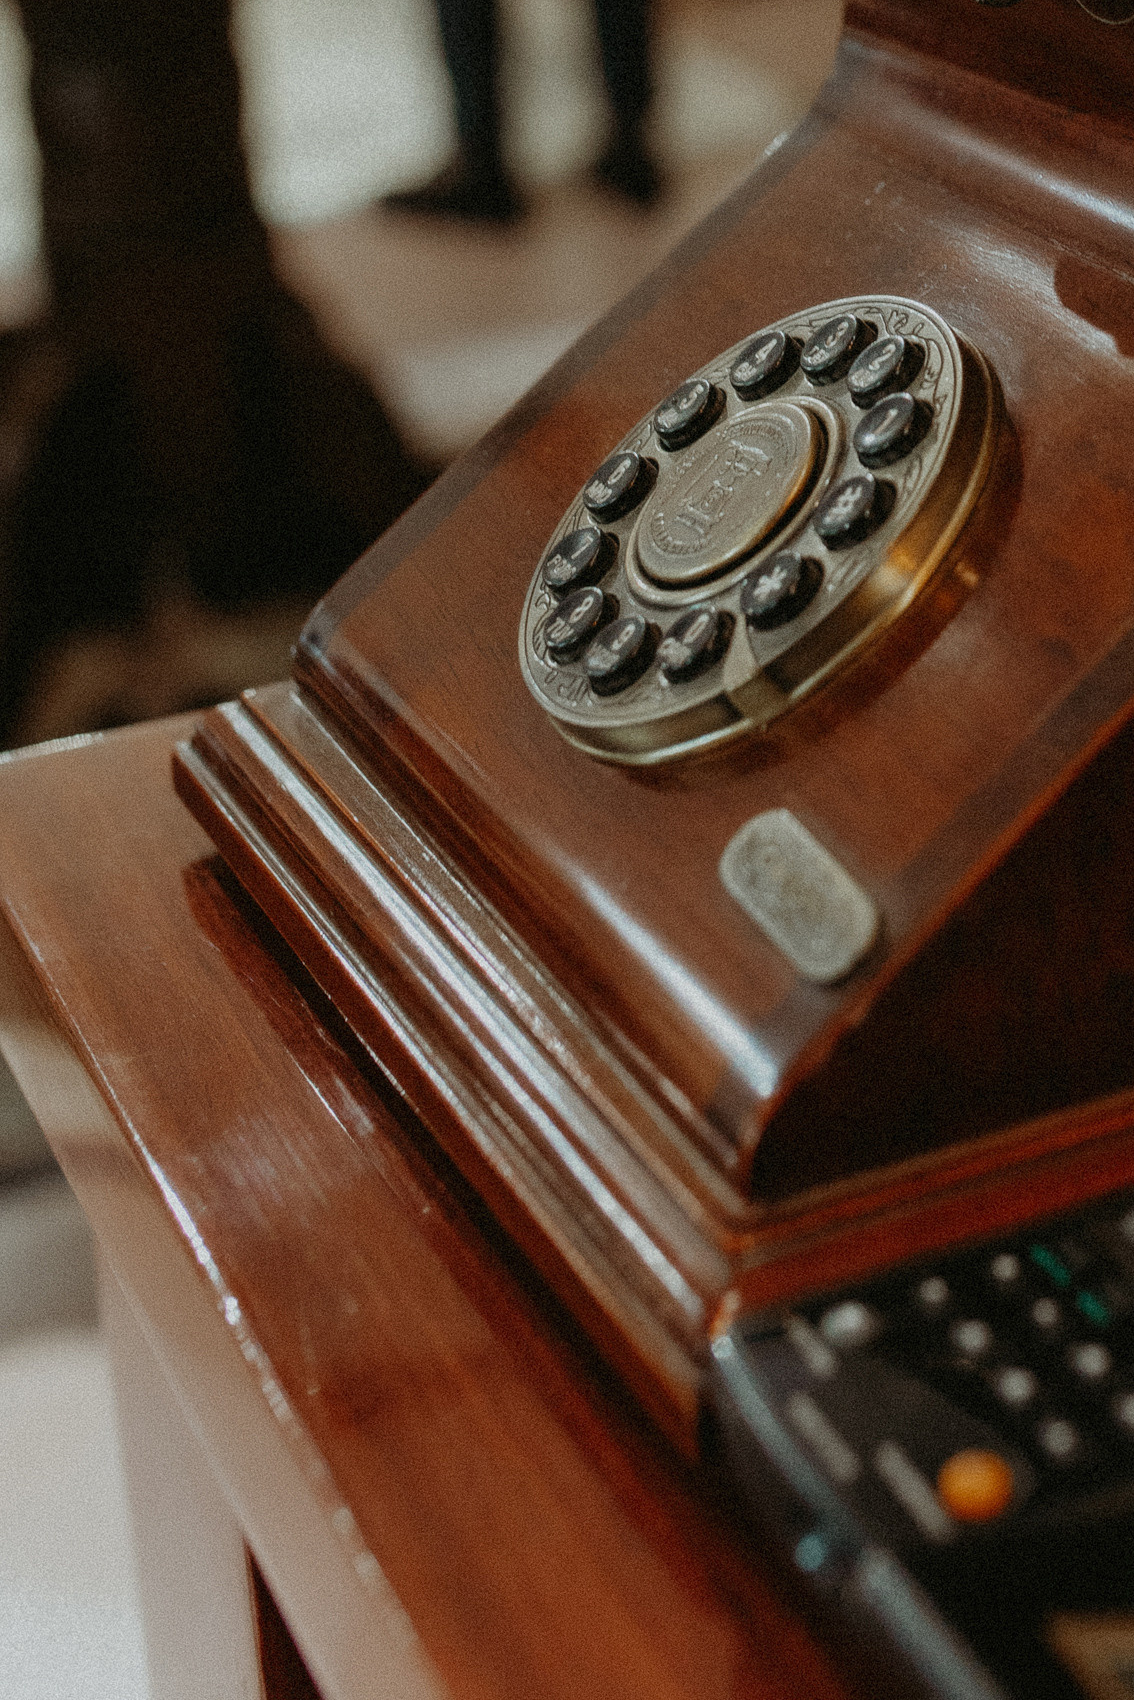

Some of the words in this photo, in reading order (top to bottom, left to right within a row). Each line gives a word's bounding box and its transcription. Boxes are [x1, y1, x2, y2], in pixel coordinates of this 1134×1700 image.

[824, 320, 849, 349] 3
[754, 338, 778, 364] 4
[868, 343, 897, 371] 2
[679, 383, 704, 410] 5
[873, 407, 899, 436] 1
[607, 457, 632, 485] 6
[570, 534, 594, 560] 7
[568, 595, 594, 624] 8
[610, 623, 636, 651] 9
